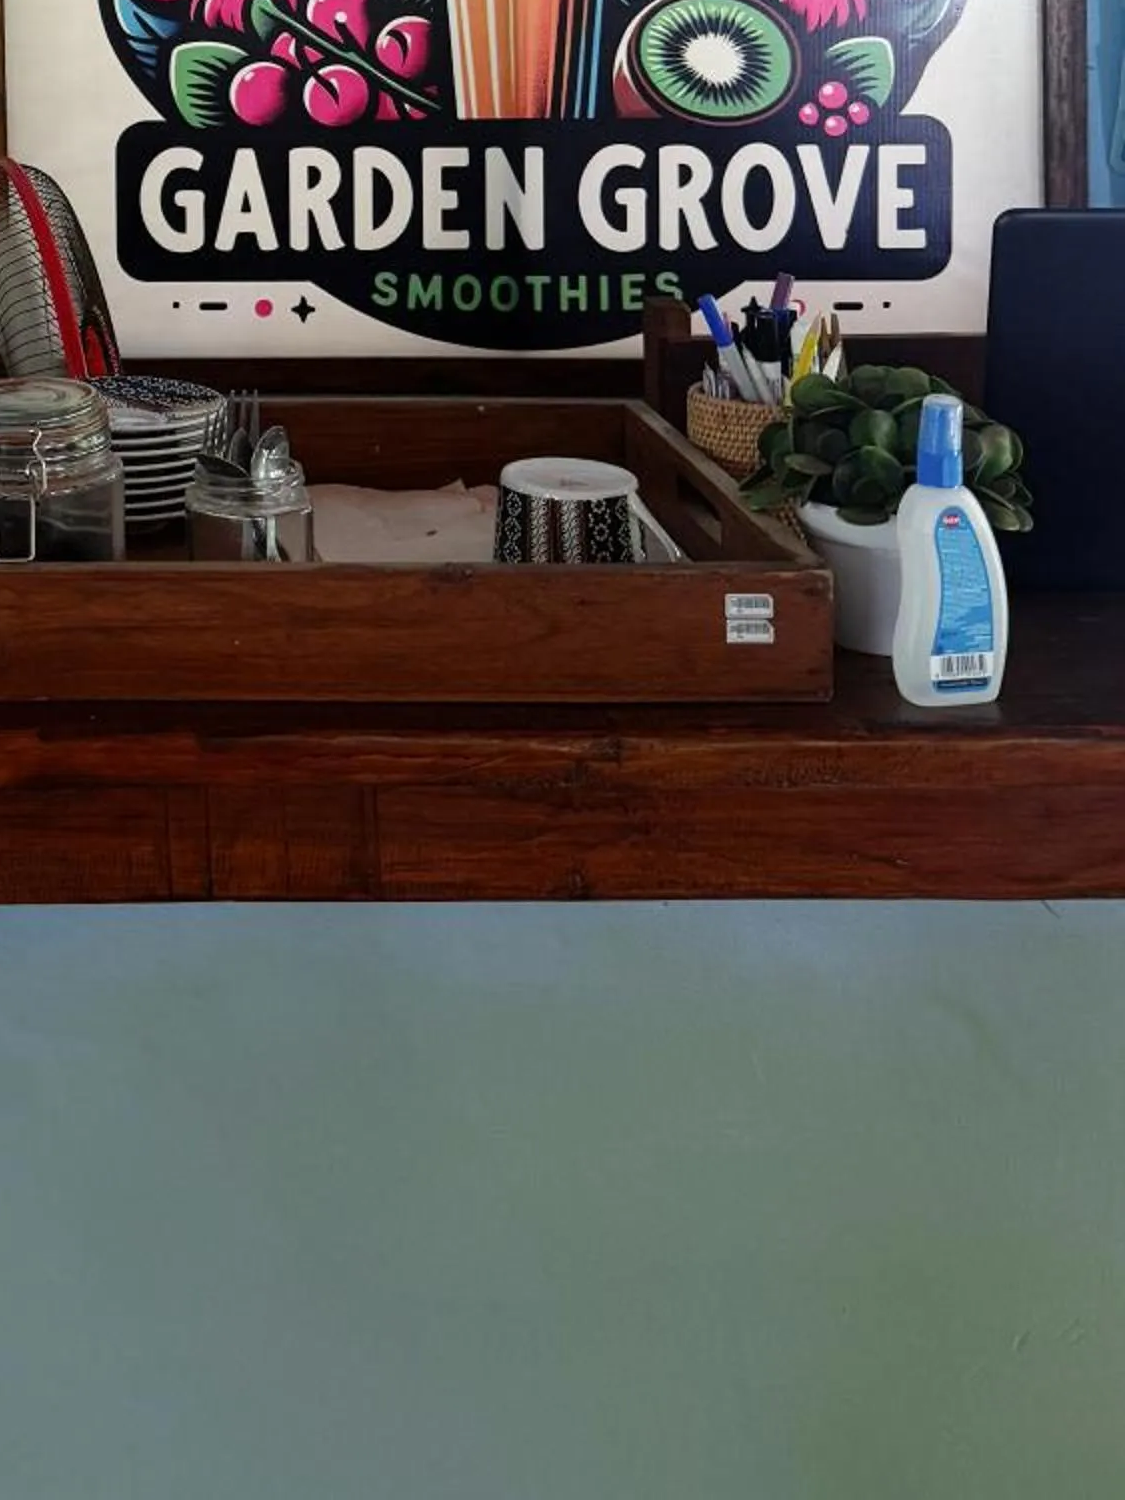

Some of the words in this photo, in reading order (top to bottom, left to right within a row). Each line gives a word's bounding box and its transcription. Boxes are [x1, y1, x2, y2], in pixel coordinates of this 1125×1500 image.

[139, 146, 545, 253] GARDEN
[577, 143, 927, 252] GROVE
[371, 271, 683, 313] SMOOTHIES
